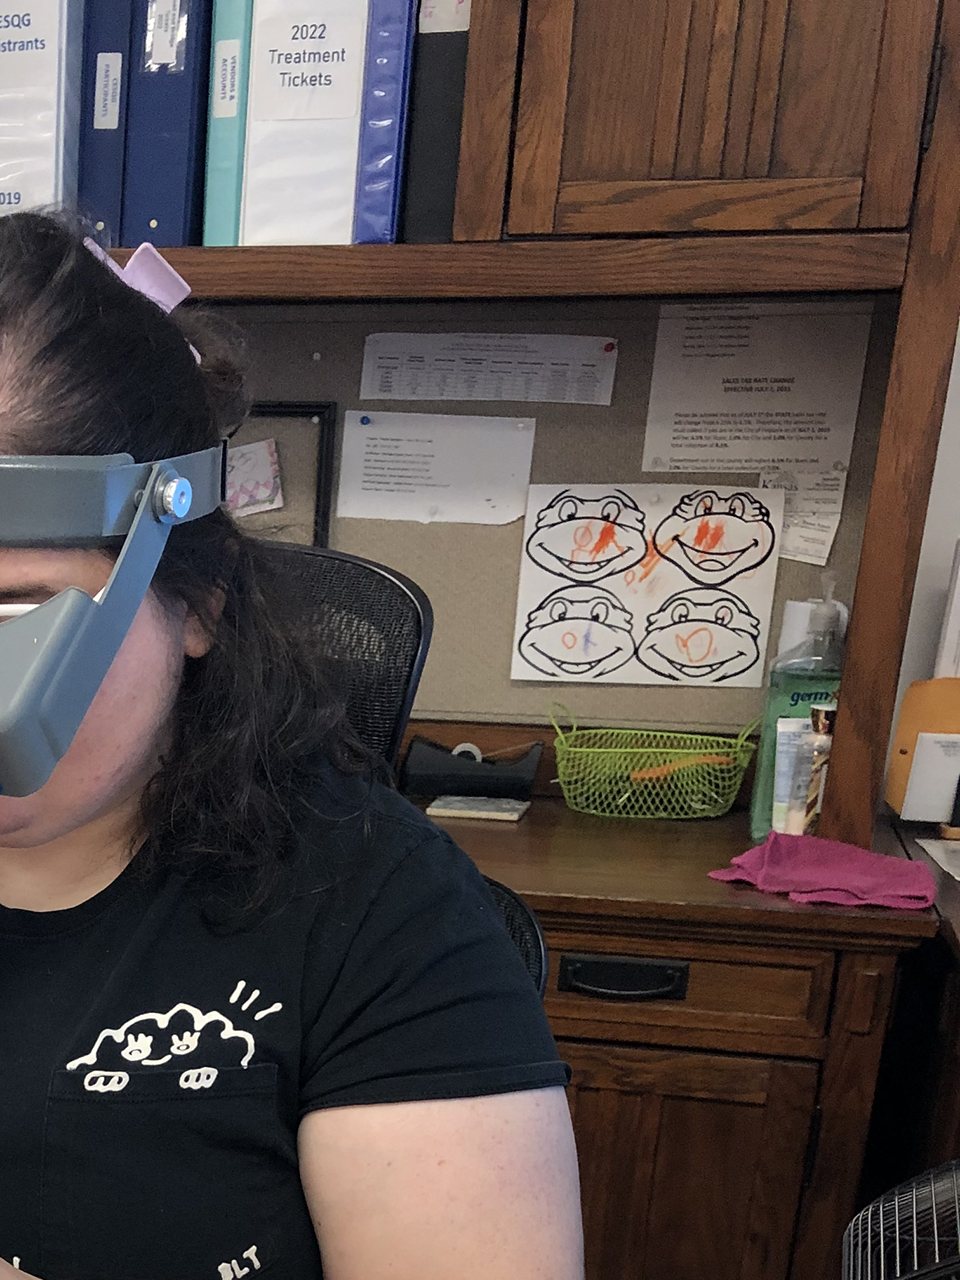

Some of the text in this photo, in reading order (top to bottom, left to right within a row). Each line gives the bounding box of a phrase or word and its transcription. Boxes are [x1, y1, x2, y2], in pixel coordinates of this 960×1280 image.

[291, 24, 326, 40] 2022
[268, 48, 346, 64] Treatment
[220, 58, 228, 100] ACCOUNTS
[228, 55, 237, 93] VENDORS
[279, 72, 332, 88] Tickets
[101, 64, 110, 118] PARTICIPANTS
